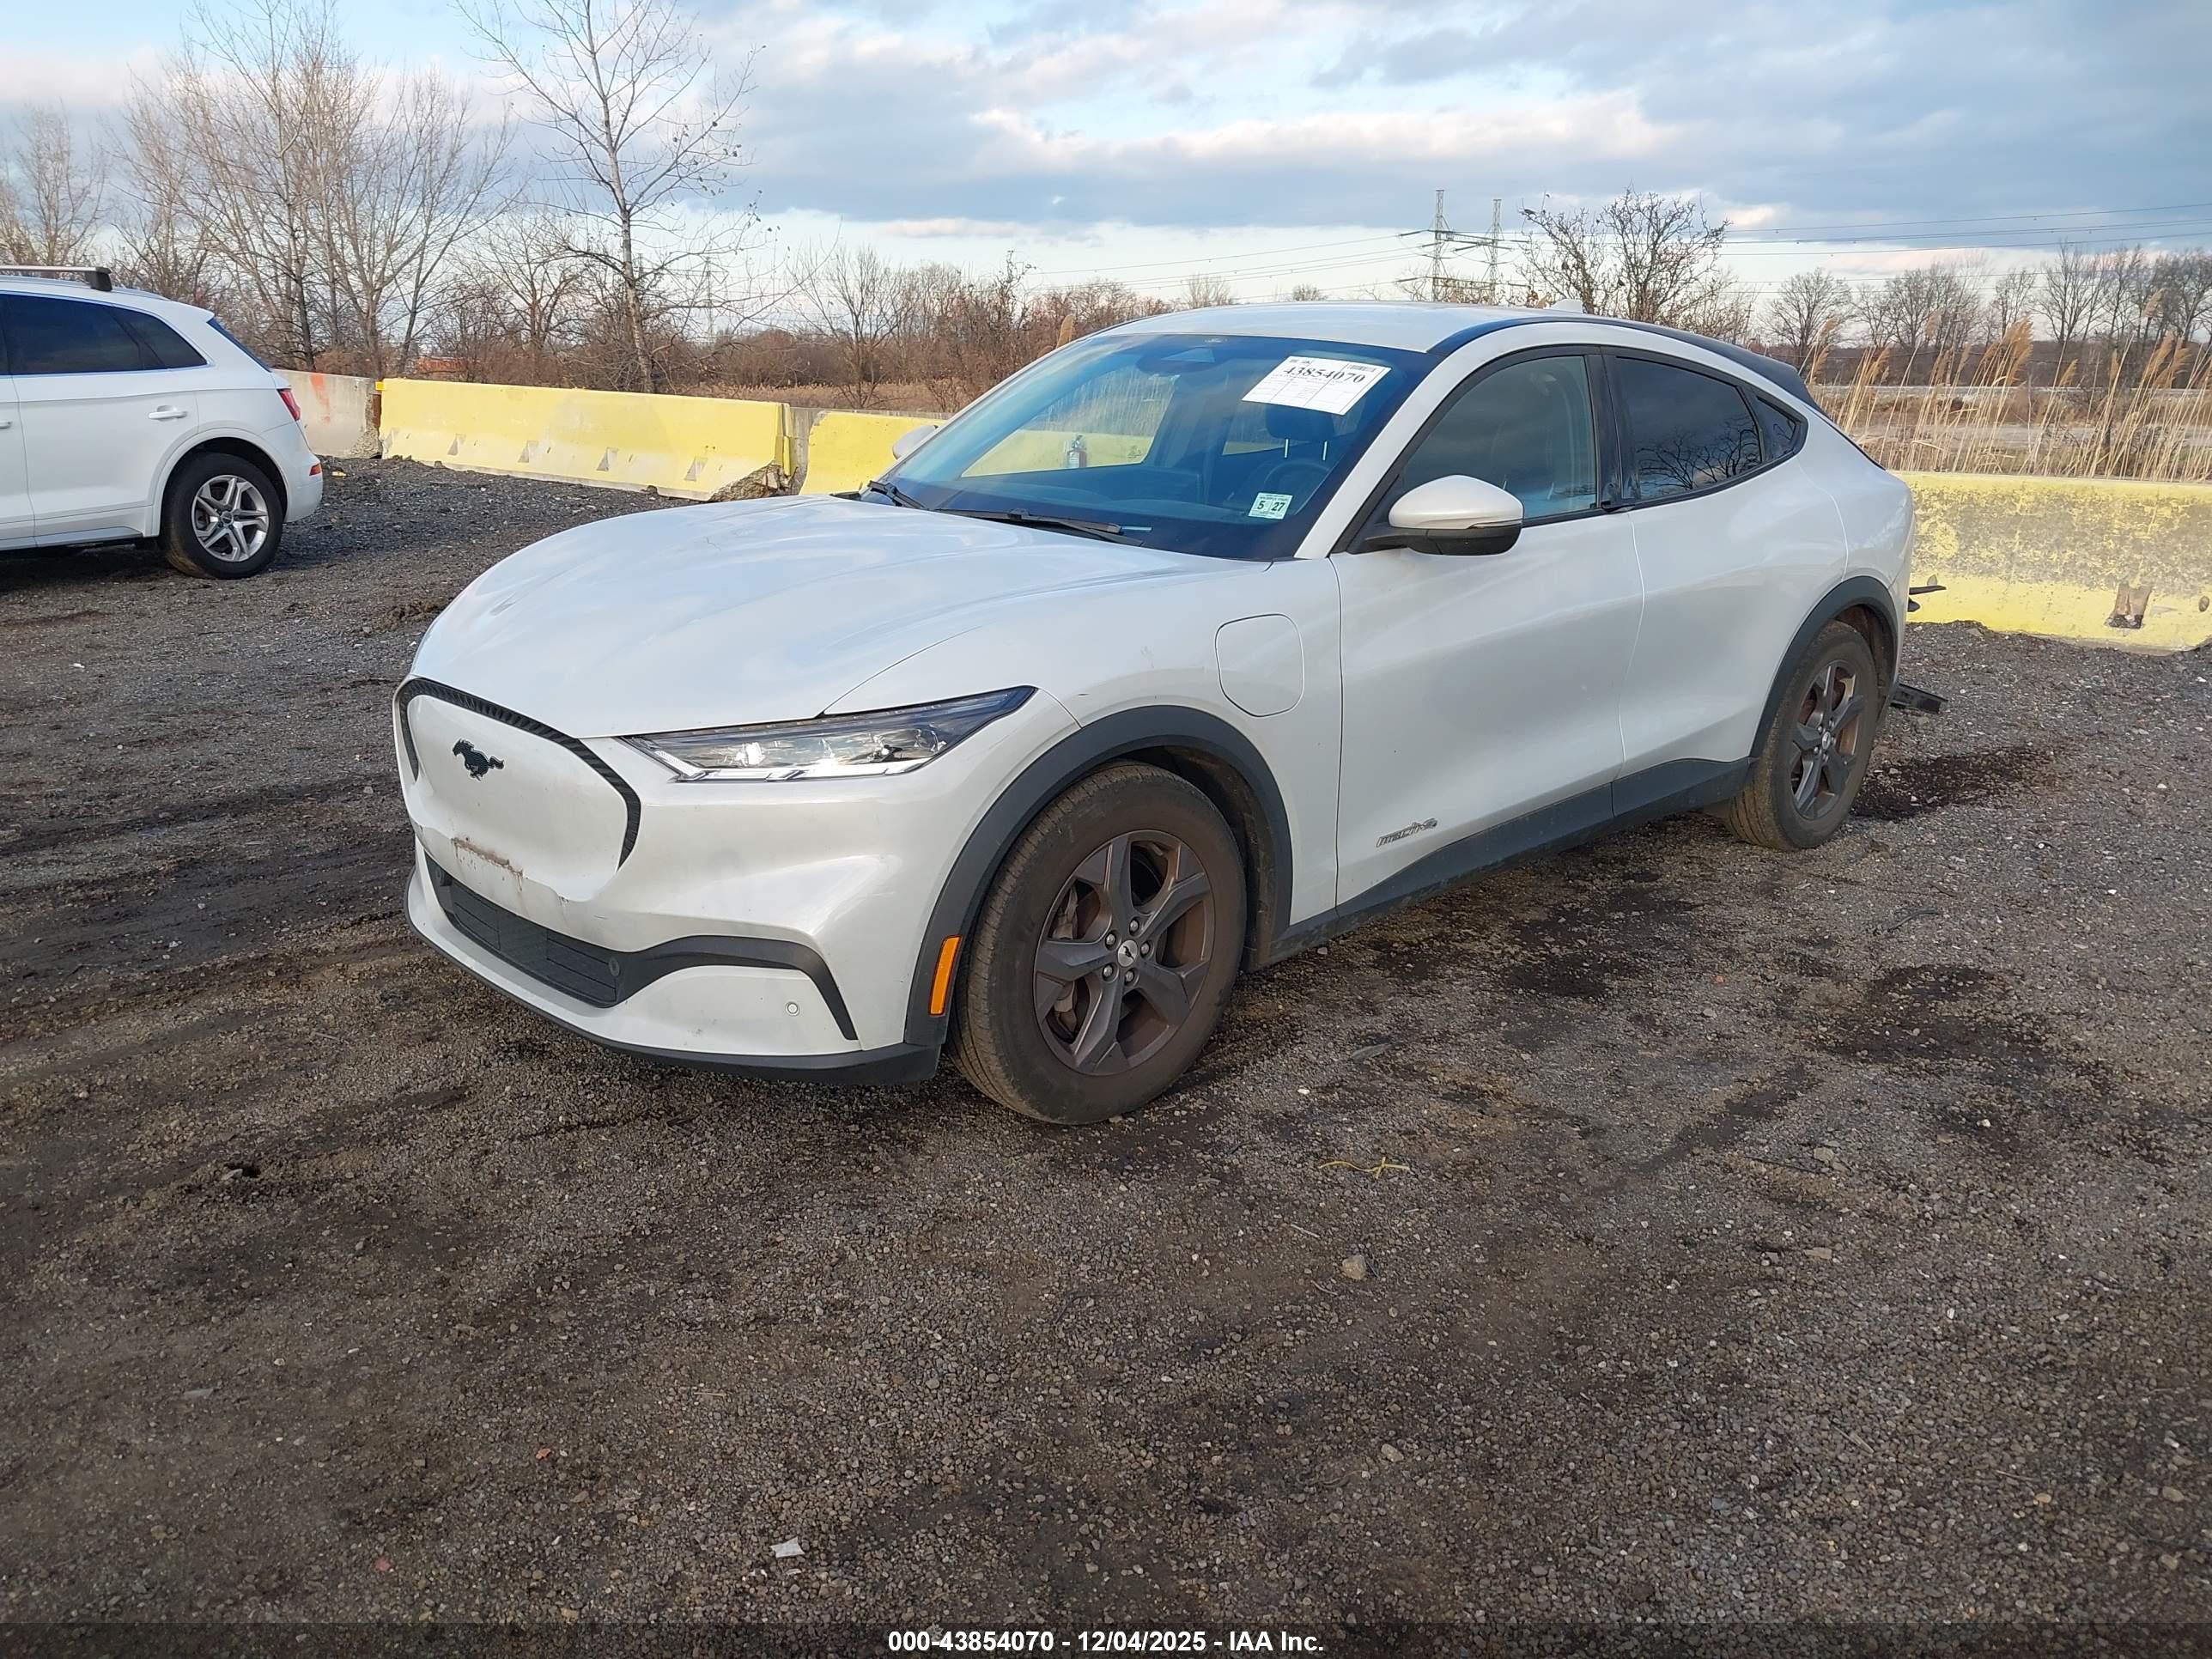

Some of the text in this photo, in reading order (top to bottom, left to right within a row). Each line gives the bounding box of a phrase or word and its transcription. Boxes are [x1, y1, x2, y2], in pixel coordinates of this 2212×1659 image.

[1283, 366, 1366, 384] 43854070
[1256, 500, 1285, 512] 5 27
